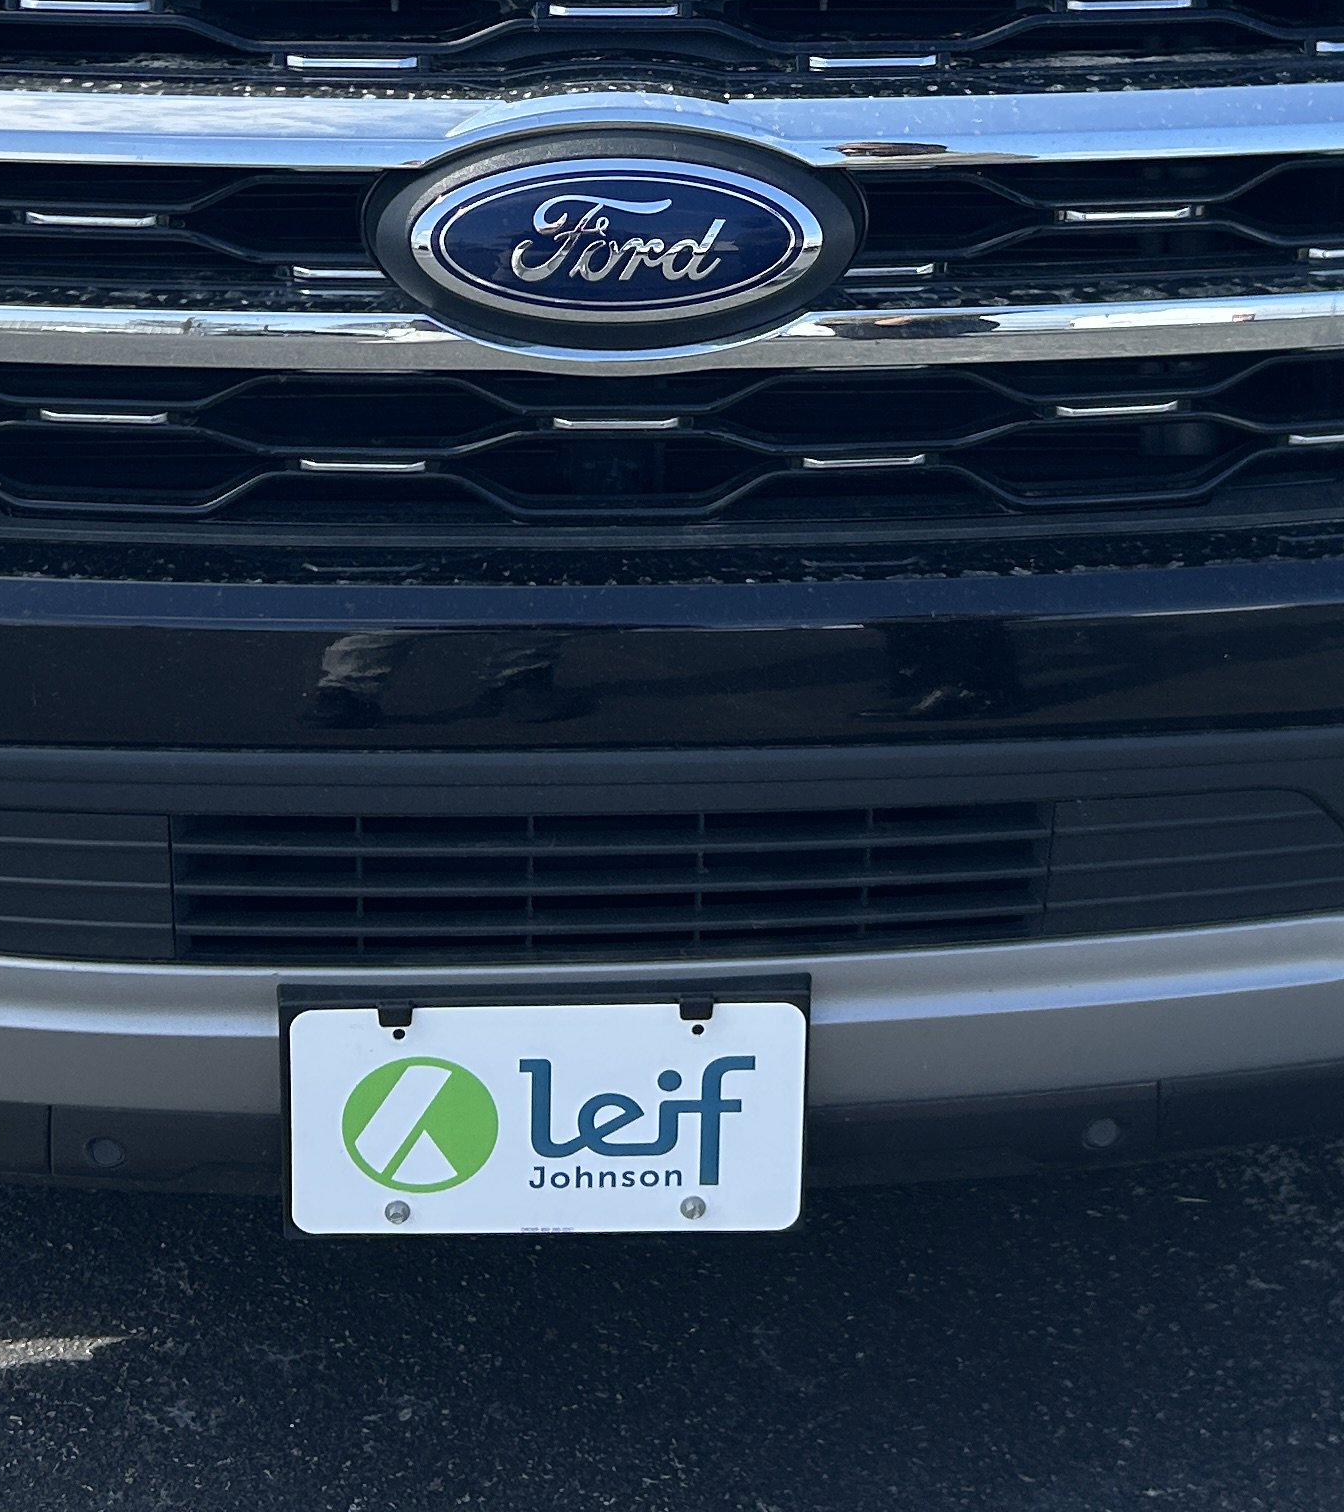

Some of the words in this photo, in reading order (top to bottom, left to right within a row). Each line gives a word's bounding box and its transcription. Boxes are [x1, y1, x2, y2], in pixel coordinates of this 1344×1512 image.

[511, 194, 726, 282] Ford
[519, 1055, 756, 1186] leif
[529, 1165, 682, 1190] Johnson
